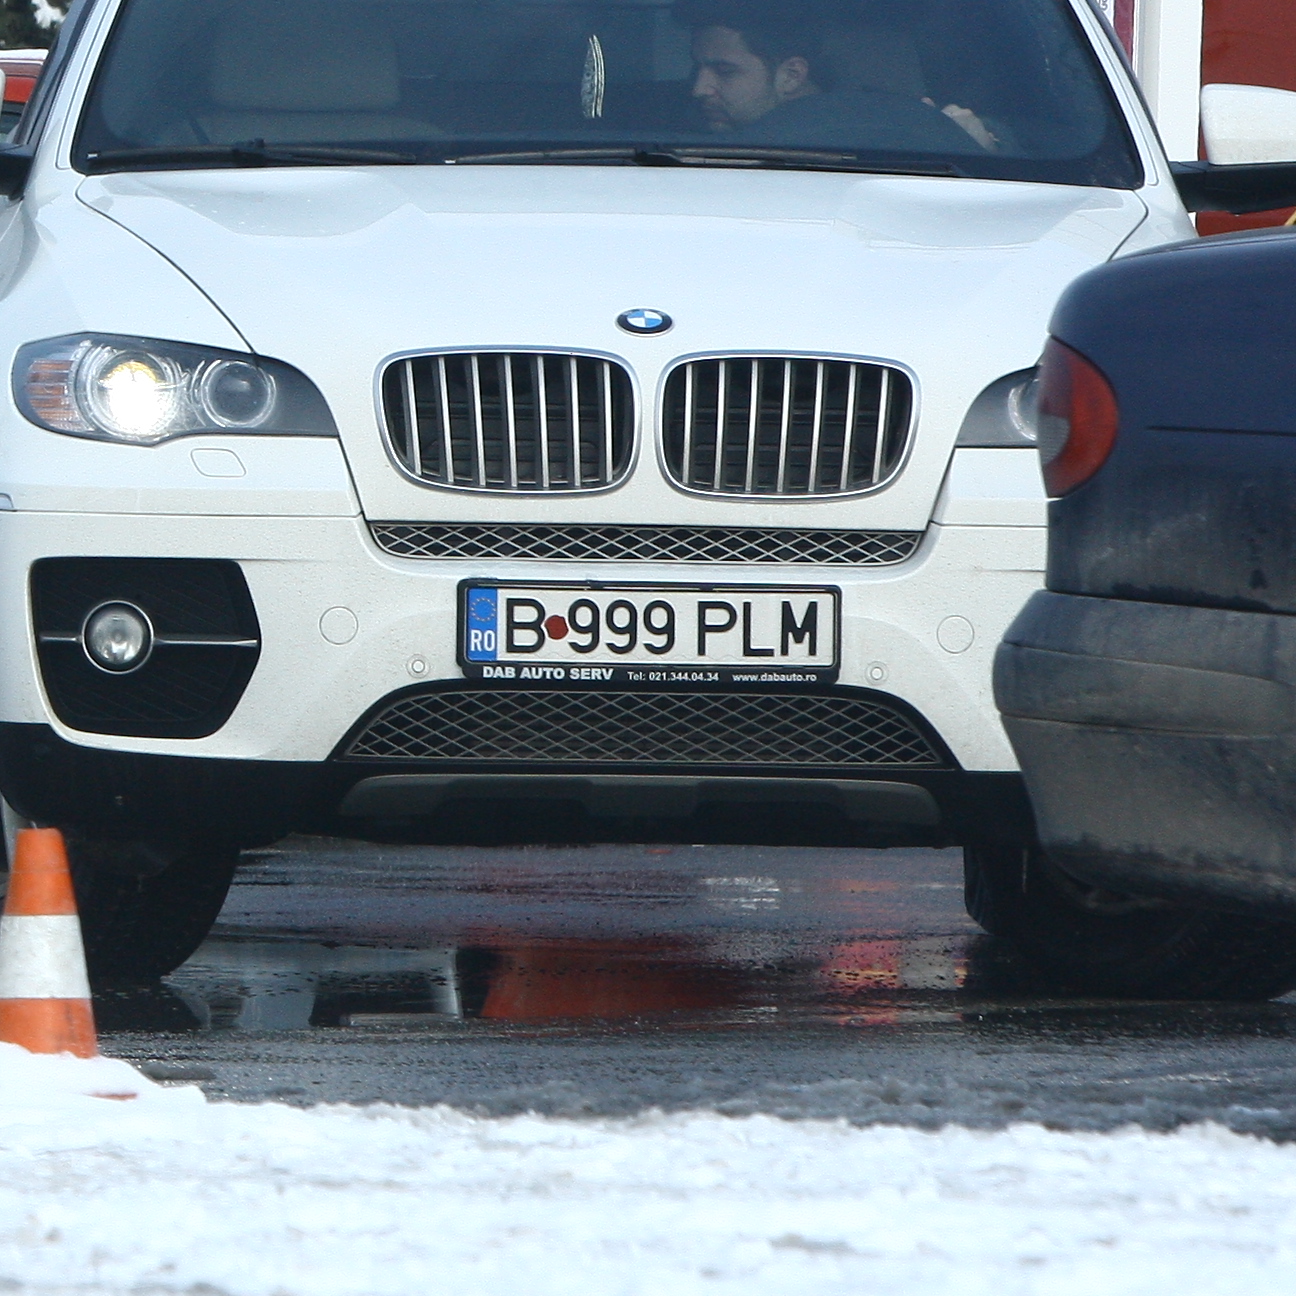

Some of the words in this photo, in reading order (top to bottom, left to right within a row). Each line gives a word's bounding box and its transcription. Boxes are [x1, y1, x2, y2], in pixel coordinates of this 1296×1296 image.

[505, 598, 546, 654] B
[568, 598, 676, 655] 999
[697, 600, 818, 657] PLM
[470, 629, 496, 652] RO
[483, 666, 516, 679] DAB
[519, 667, 565, 680] AUTO
[569, 667, 614, 680] SERV
[627, 671, 646, 681] Tel:
[648, 671, 719, 682] 021.344.04.34
[731, 672, 818, 682] www.dabauto.ro
